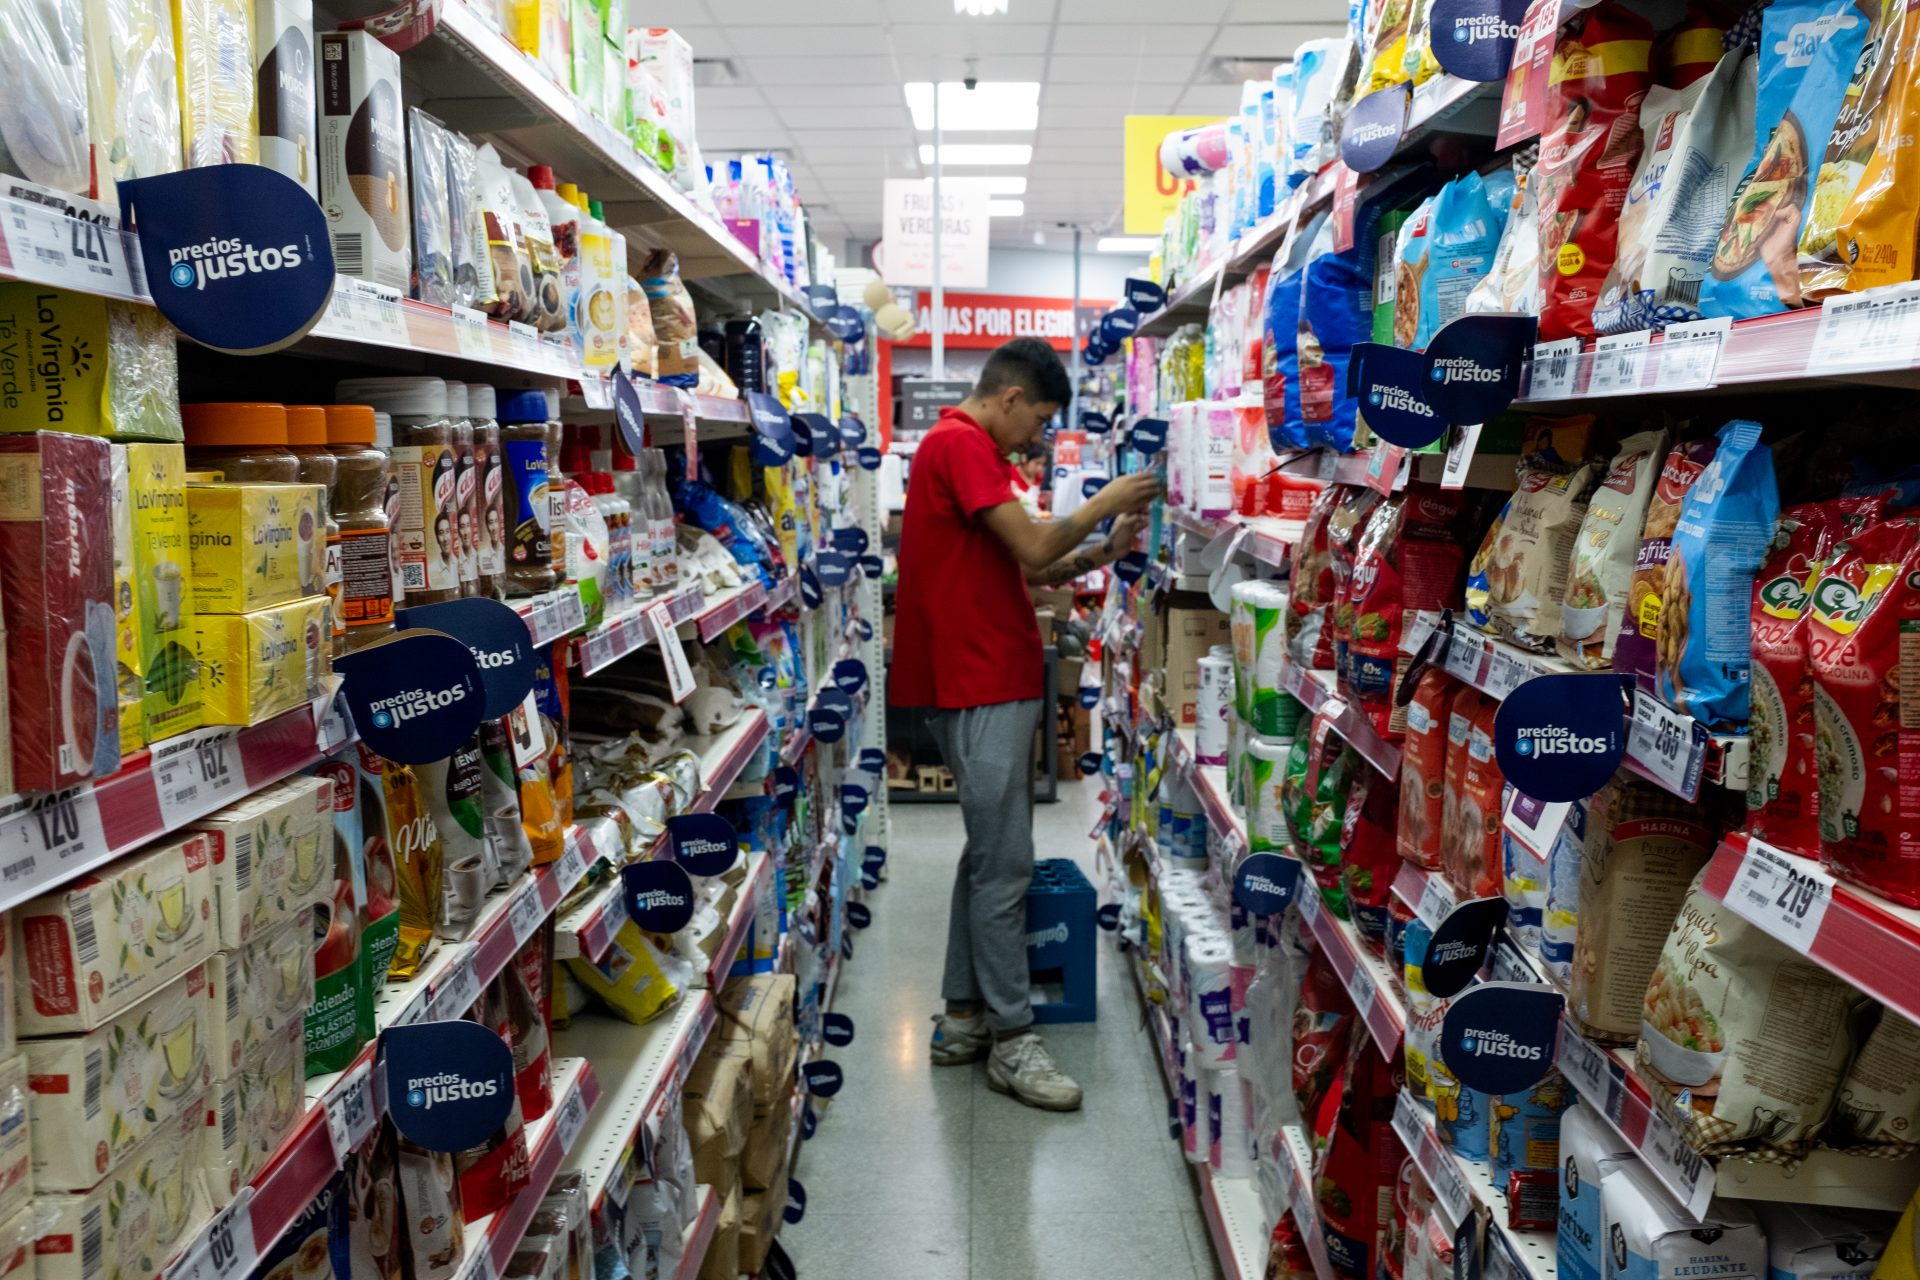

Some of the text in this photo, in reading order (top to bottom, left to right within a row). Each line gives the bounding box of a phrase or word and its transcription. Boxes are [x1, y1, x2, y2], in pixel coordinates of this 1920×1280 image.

[1455, 14, 1500, 27] precios
[1469, 20, 1520, 45] justo
[1353, 122, 1378, 134] precios
[1359, 123, 1396, 146] justos
[904, 193, 954, 213] FRUAS
[899, 216, 972, 235] VERRAS
[169, 237, 242, 266] precios
[1873, 244, 1897, 269] 240g
[195, 244, 302, 291] justos
[975, 308, 1012, 336] POR
[37, 294, 67, 422] LaVirginia
[1434, 357, 1475, 368] precios
[1444, 365, 1501, 385] justos
[1371, 384, 1409, 398] precios
[1381, 394, 1434, 417] justos
[189, 531, 232, 550] ginia
[475, 648, 514, 669] tos
[370, 688, 425, 714] precios
[391, 683, 466, 728] justos
[1517, 724, 1569, 739] precios
[1533, 733, 1607, 759] justos
[1840, 725, 1860, 781] cremoso
[1641, 823, 1689, 836] HARINA
[680, 838, 707, 848] precios
[690, 842, 727, 857] justos
[1246, 874, 1271, 884] precios
[1250, 881, 1286, 896] justos
[637, 889, 666, 900] precios
[646, 893, 684, 911] justos
[1776, 868, 1817, 918] 219
[1436, 940, 1463, 950] precios
[1440, 943, 1477, 966] justos
[1464, 1028, 1510, 1042] precios
[1475, 1039, 1541, 1061] justos
[408, 1073, 460, 1091] precios
[425, 1079, 497, 1110] justos
[1690, 1255, 1729, 1264] HARINA
[1674, 1263, 1747, 1276] LEUDANTE
